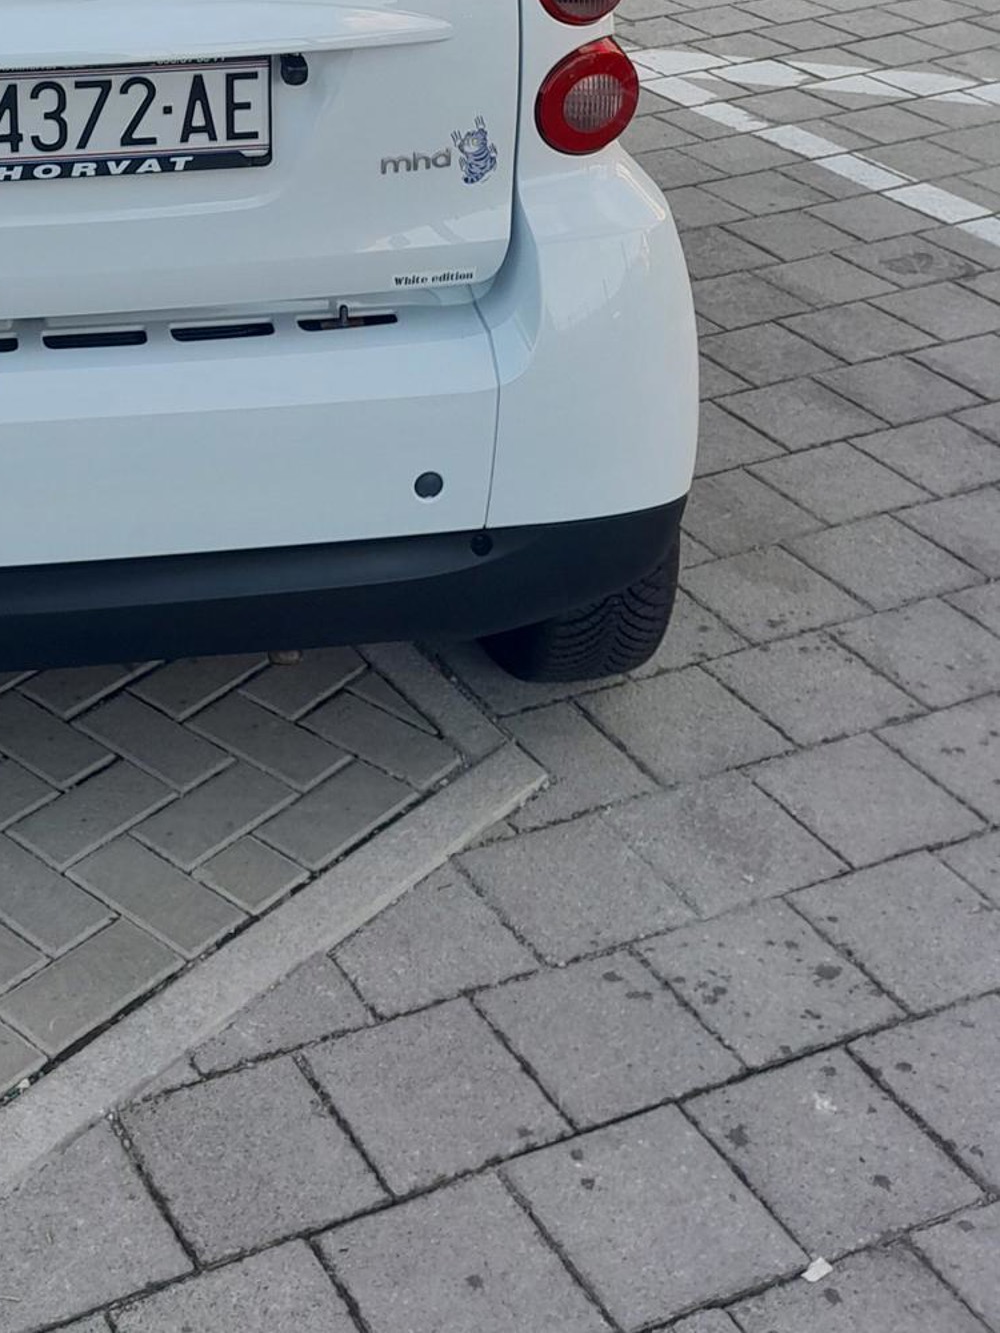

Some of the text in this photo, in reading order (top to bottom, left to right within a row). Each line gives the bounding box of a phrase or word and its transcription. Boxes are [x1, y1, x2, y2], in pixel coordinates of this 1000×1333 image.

[381, 149, 451, 175] mhd
[394, 271, 474, 286] White edition
